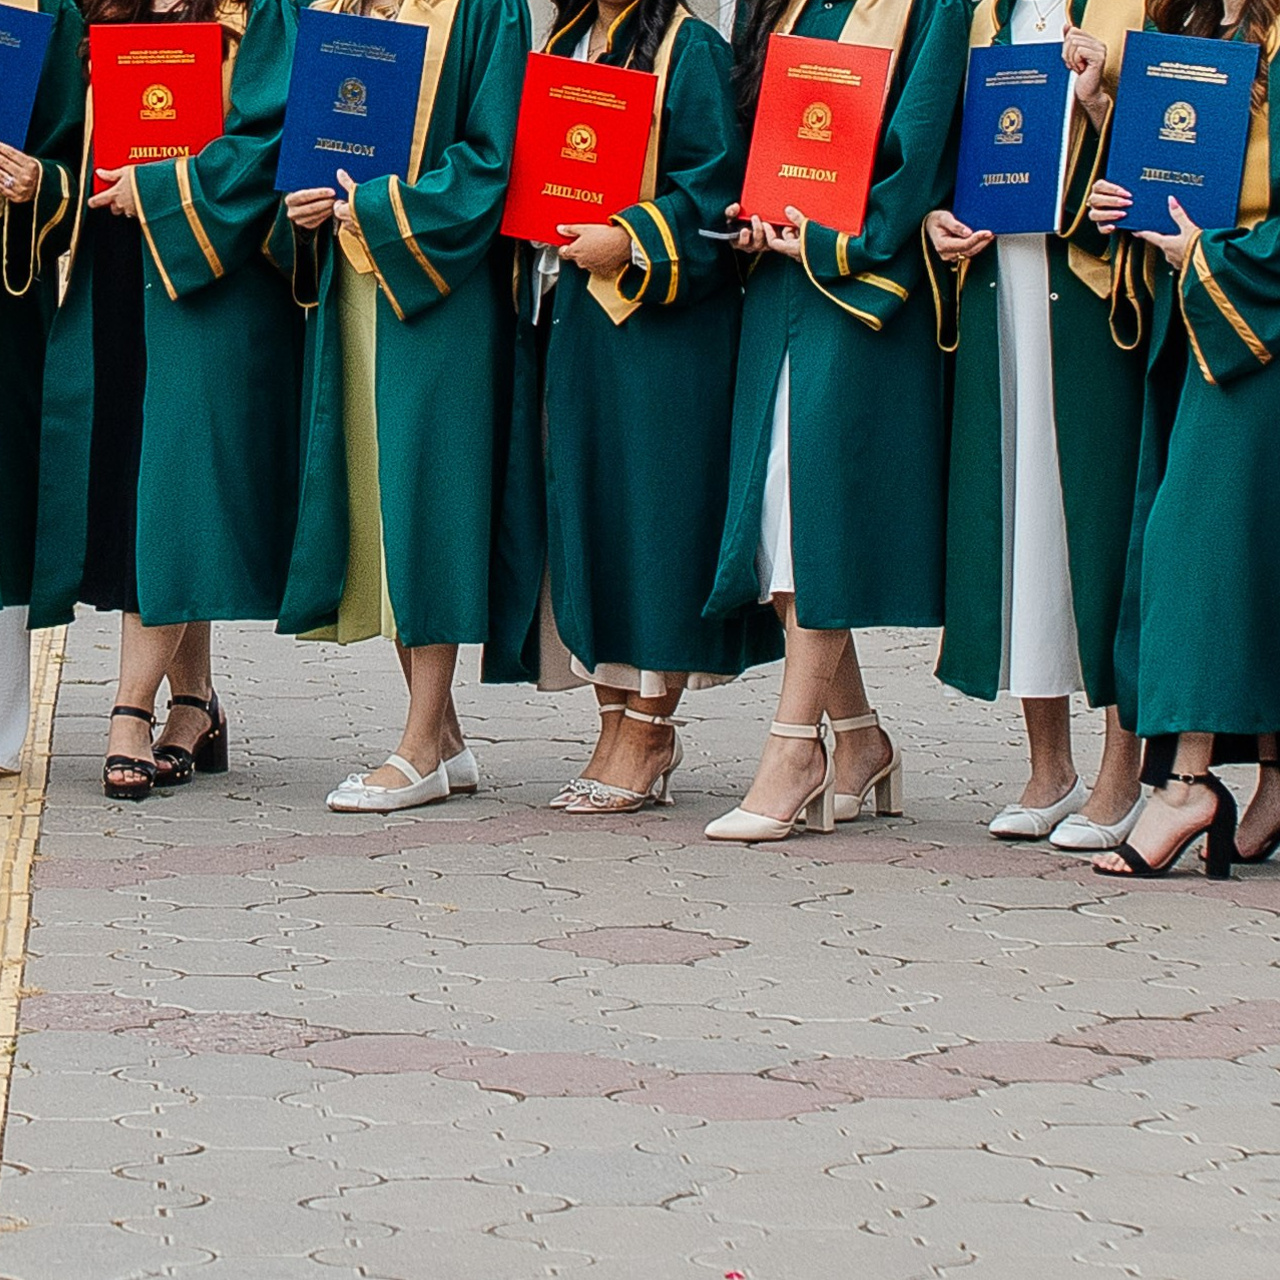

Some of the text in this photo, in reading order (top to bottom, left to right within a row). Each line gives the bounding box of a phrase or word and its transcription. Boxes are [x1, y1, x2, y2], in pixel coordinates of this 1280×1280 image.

[128, 145, 190, 159] ДИПЛОМ
[314, 137, 375, 158] ДИПЛОМ
[778, 163, 838, 183] ДИПЛОМ
[980, 172, 1030, 187] ДИПЛОМ
[541, 182, 604, 205] ДИПЛОМ
